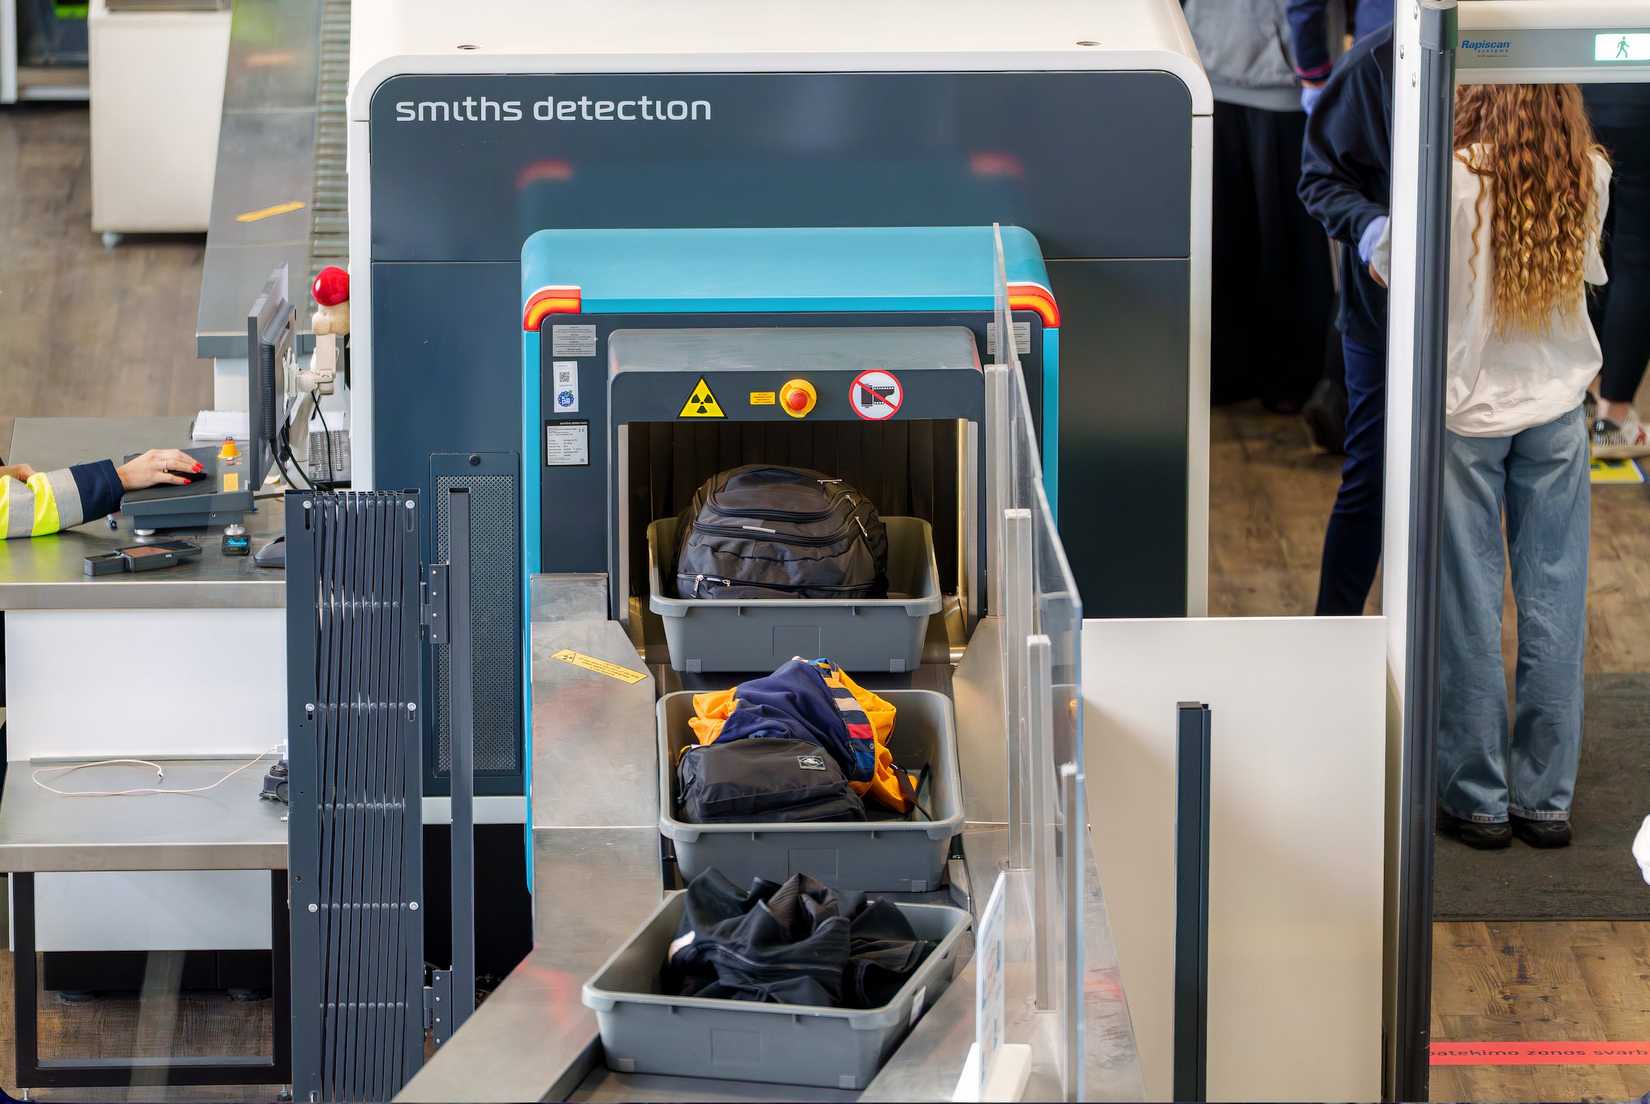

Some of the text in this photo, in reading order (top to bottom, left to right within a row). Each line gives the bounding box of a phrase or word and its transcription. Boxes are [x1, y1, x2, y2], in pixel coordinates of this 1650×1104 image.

[1461, 40, 1510, 50] Rapiscan
[396, 96, 711, 121] smiths detection
